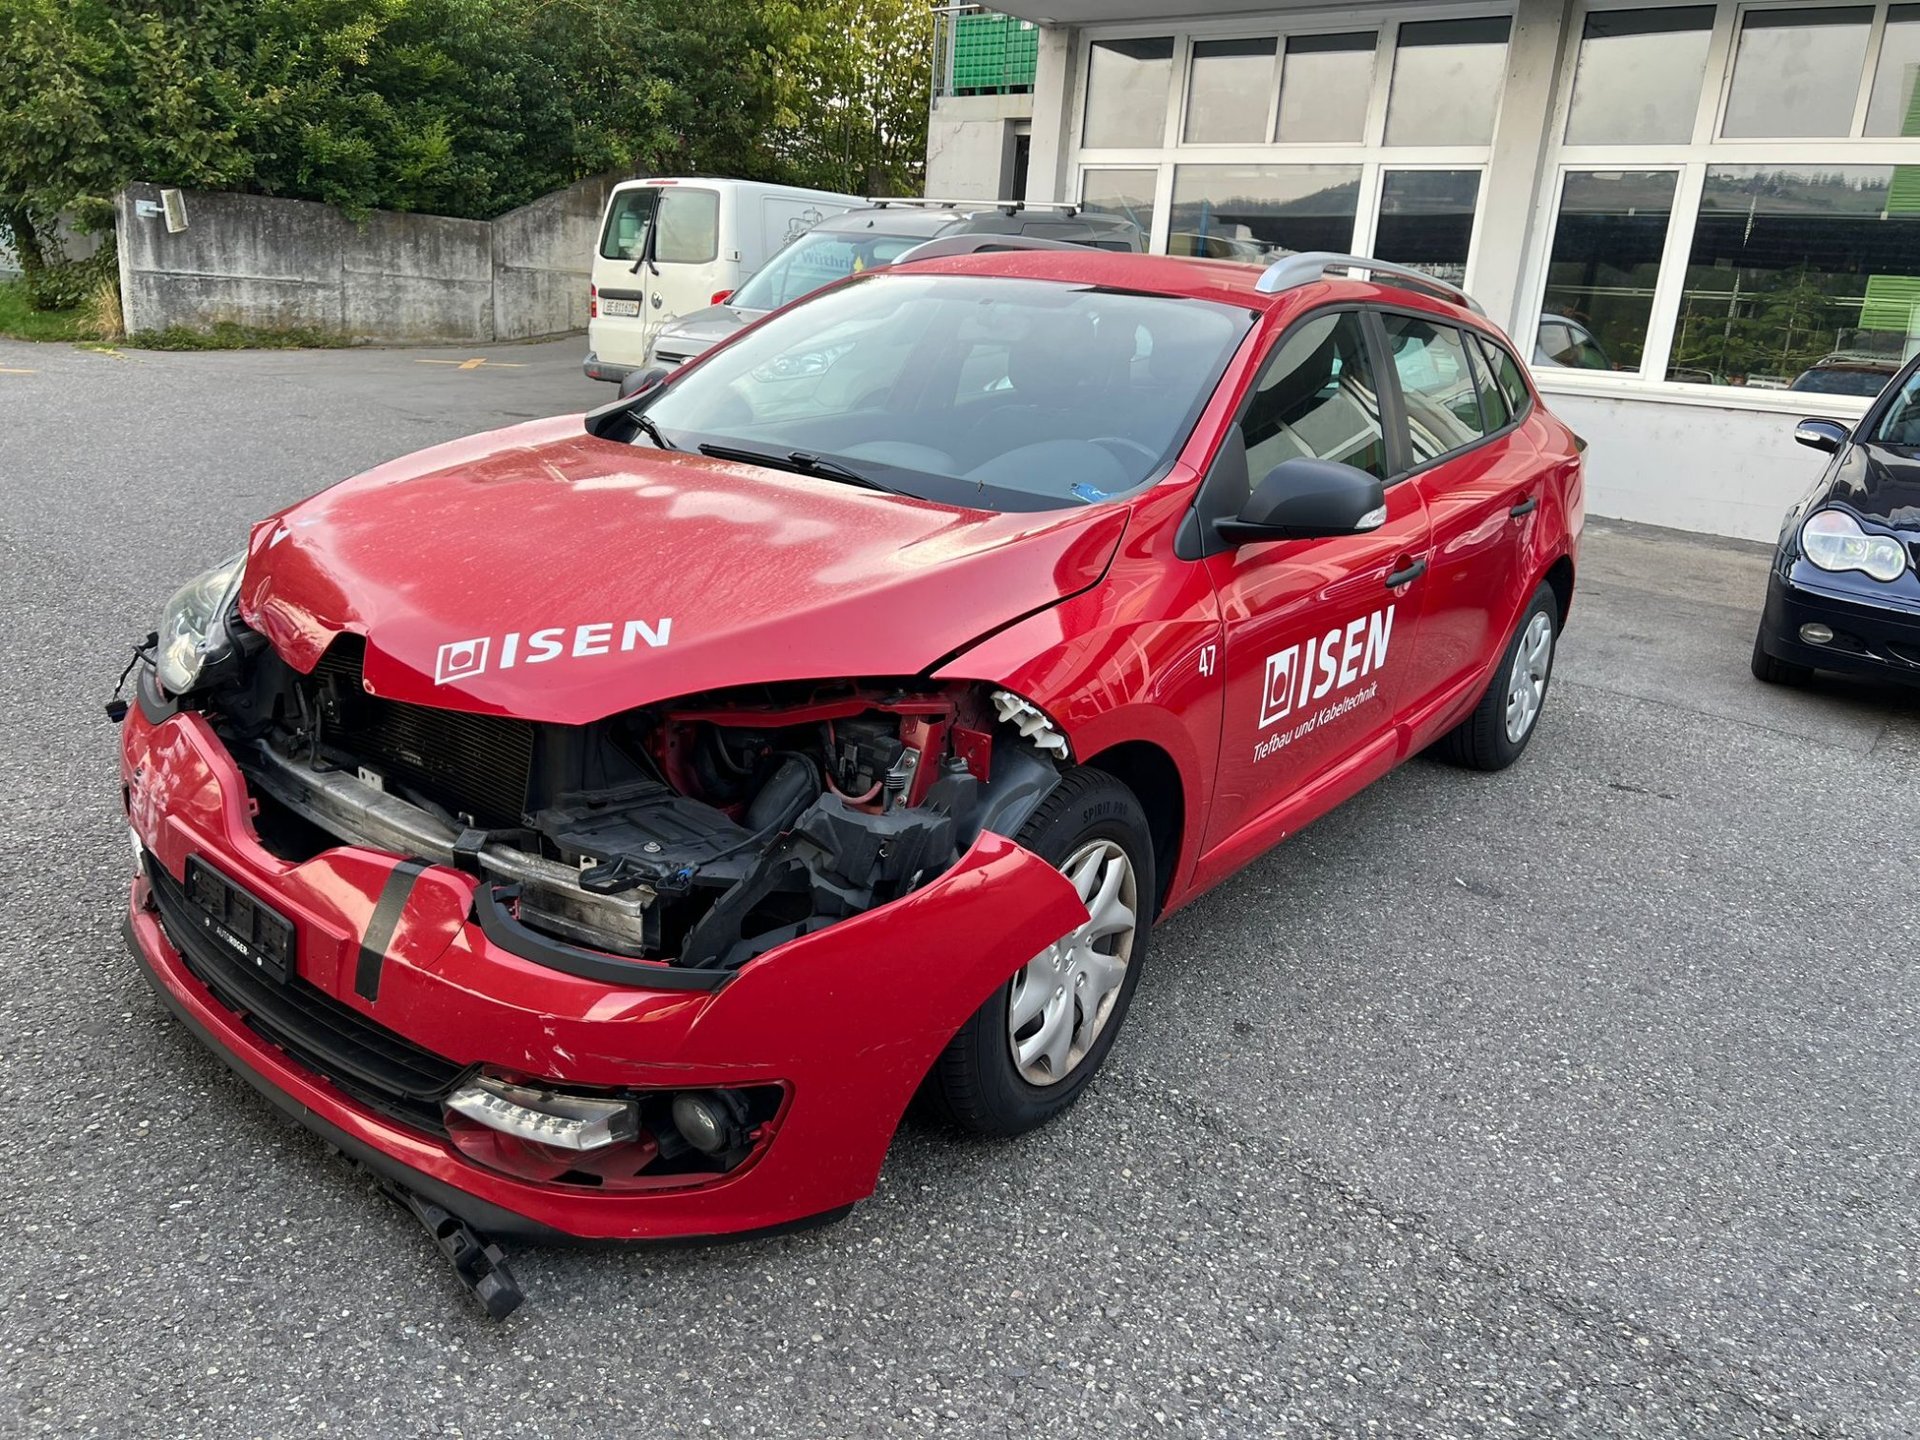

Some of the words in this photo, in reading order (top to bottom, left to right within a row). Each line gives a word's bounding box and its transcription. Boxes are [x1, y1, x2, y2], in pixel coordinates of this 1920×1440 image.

[499, 617, 673, 669] ISEN
[1198, 644, 1216, 677] 47
[1297, 604, 1395, 709] ISEN
[1252, 729, 1293, 763] Tiefbau
[1294, 712, 1316, 739] und
[1316, 681, 1378, 728] Kabeltechnik
[1082, 801, 1111, 824] SPIRIT
